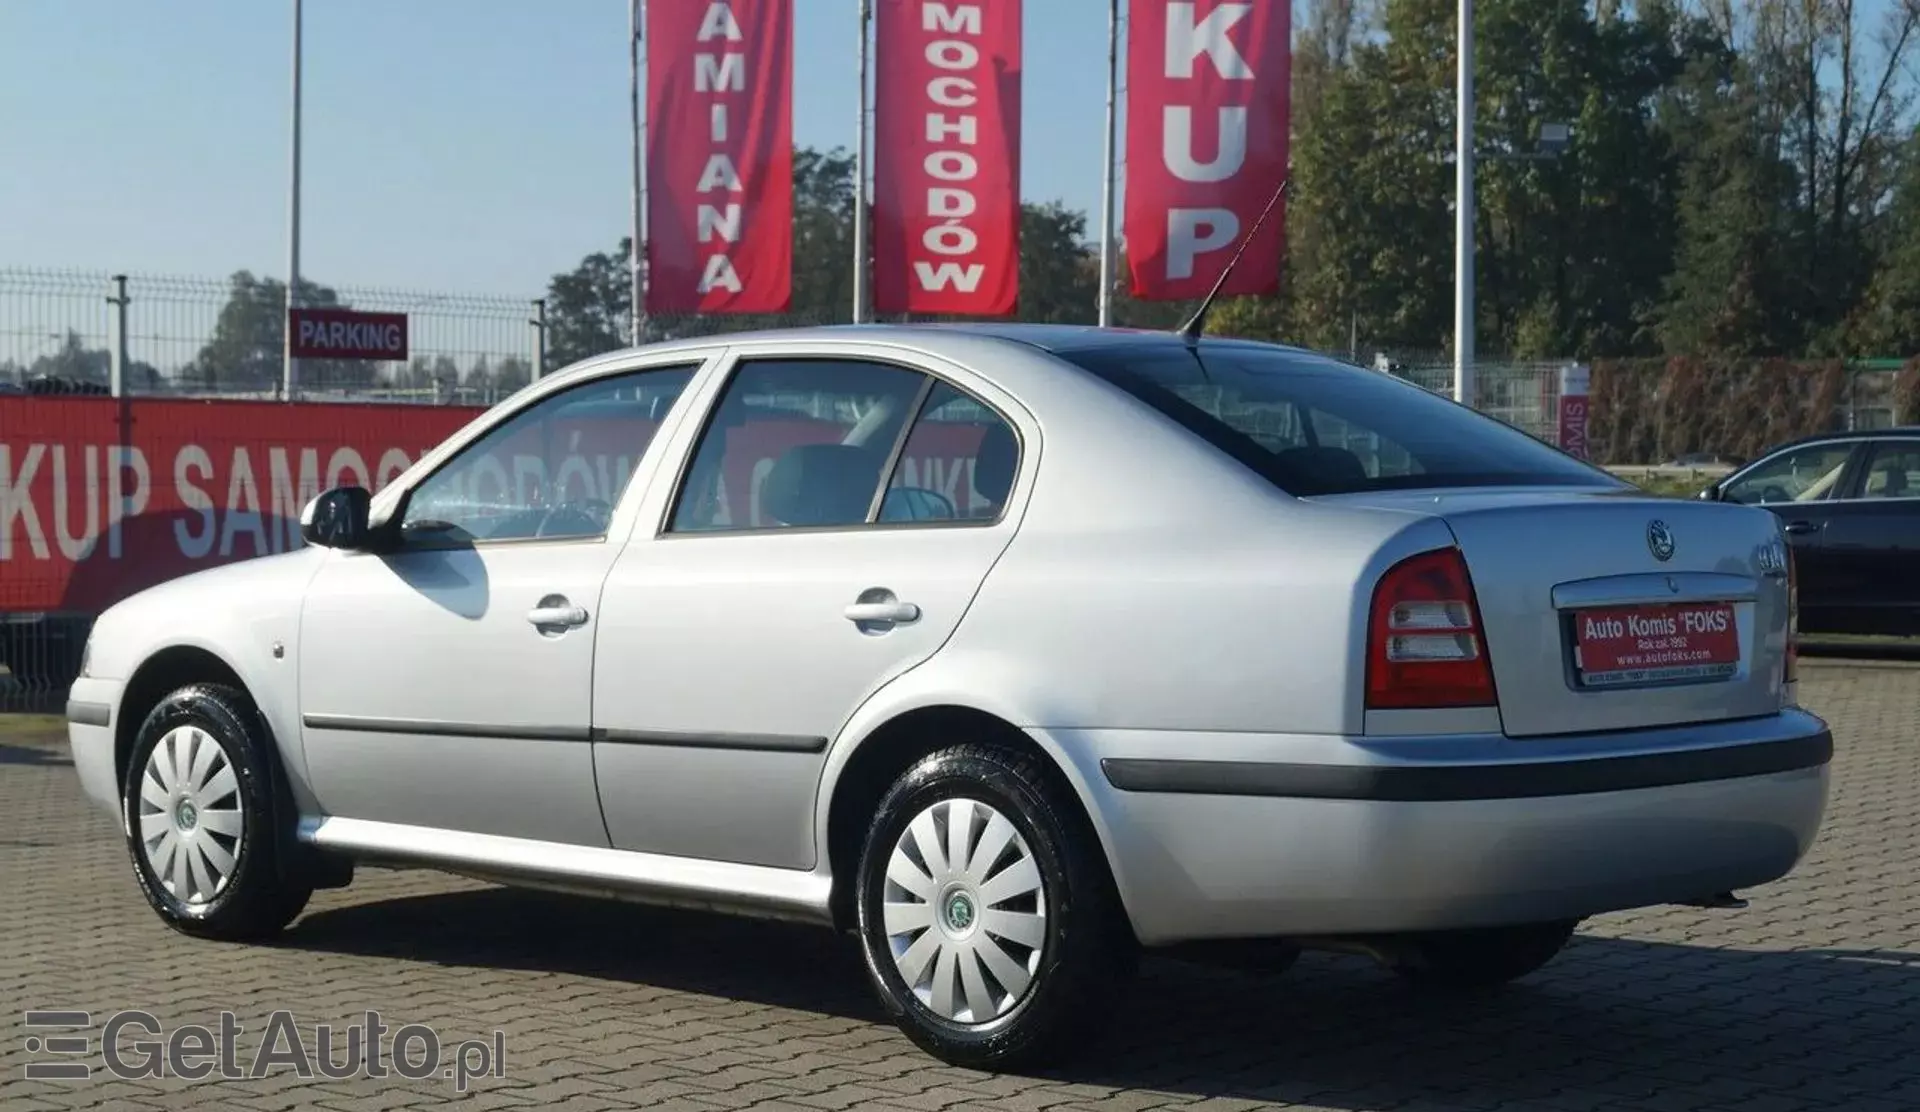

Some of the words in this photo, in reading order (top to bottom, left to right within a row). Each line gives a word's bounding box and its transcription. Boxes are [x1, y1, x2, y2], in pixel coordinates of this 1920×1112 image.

[695, 1, 745, 294] AMIANA
[916, 2, 986, 293] MOCHODÓW
[1163, 1, 1256, 280] KUP
[299, 320, 400, 351] PARKING
[0, 443, 151, 563] KUP
[1585, 617, 1623, 639] Auto
[1628, 614, 1677, 637] Komis
[1678, 610, 1731, 633] "FOKS"
[1617, 650, 1712, 665] www.autofoks.com
